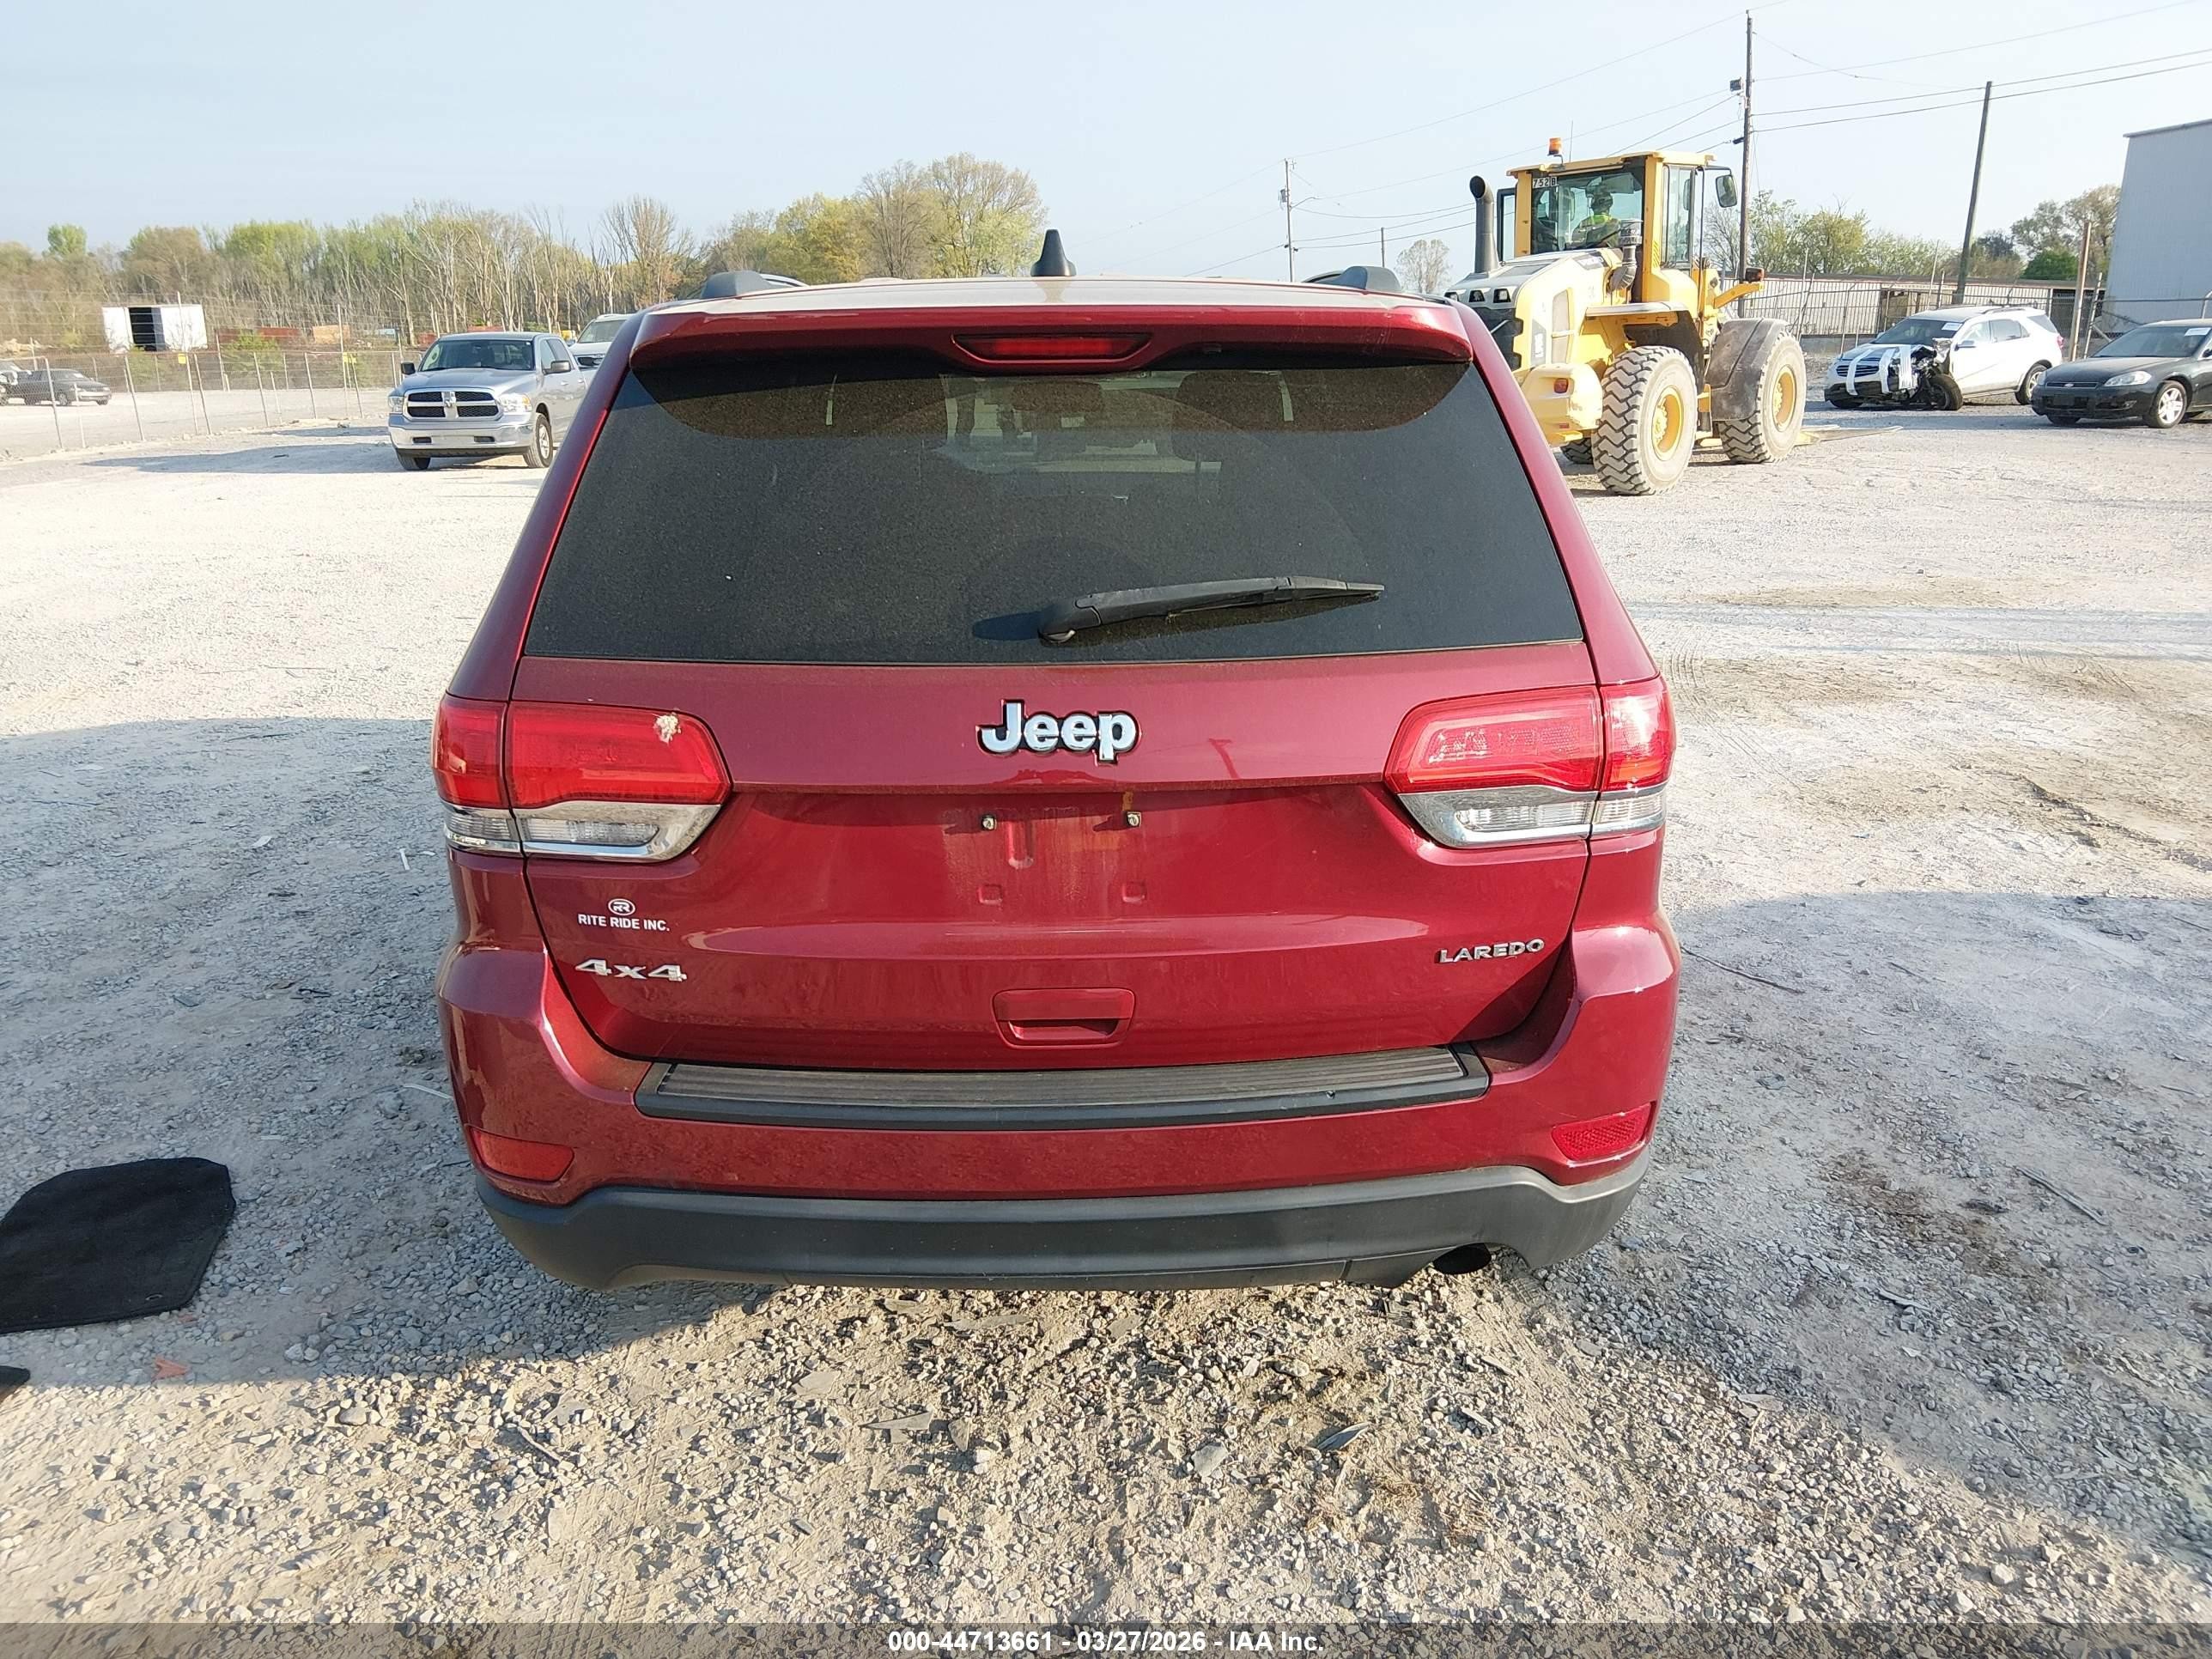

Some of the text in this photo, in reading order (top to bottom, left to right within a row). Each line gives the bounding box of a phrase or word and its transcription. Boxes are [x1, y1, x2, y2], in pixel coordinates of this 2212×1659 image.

[980, 701, 1139, 763] Jeep
[577, 914, 671, 932] RITE RIDE INC.
[1438, 939, 1545, 963] LAREDO
[574, 958, 687, 981] 4x4
